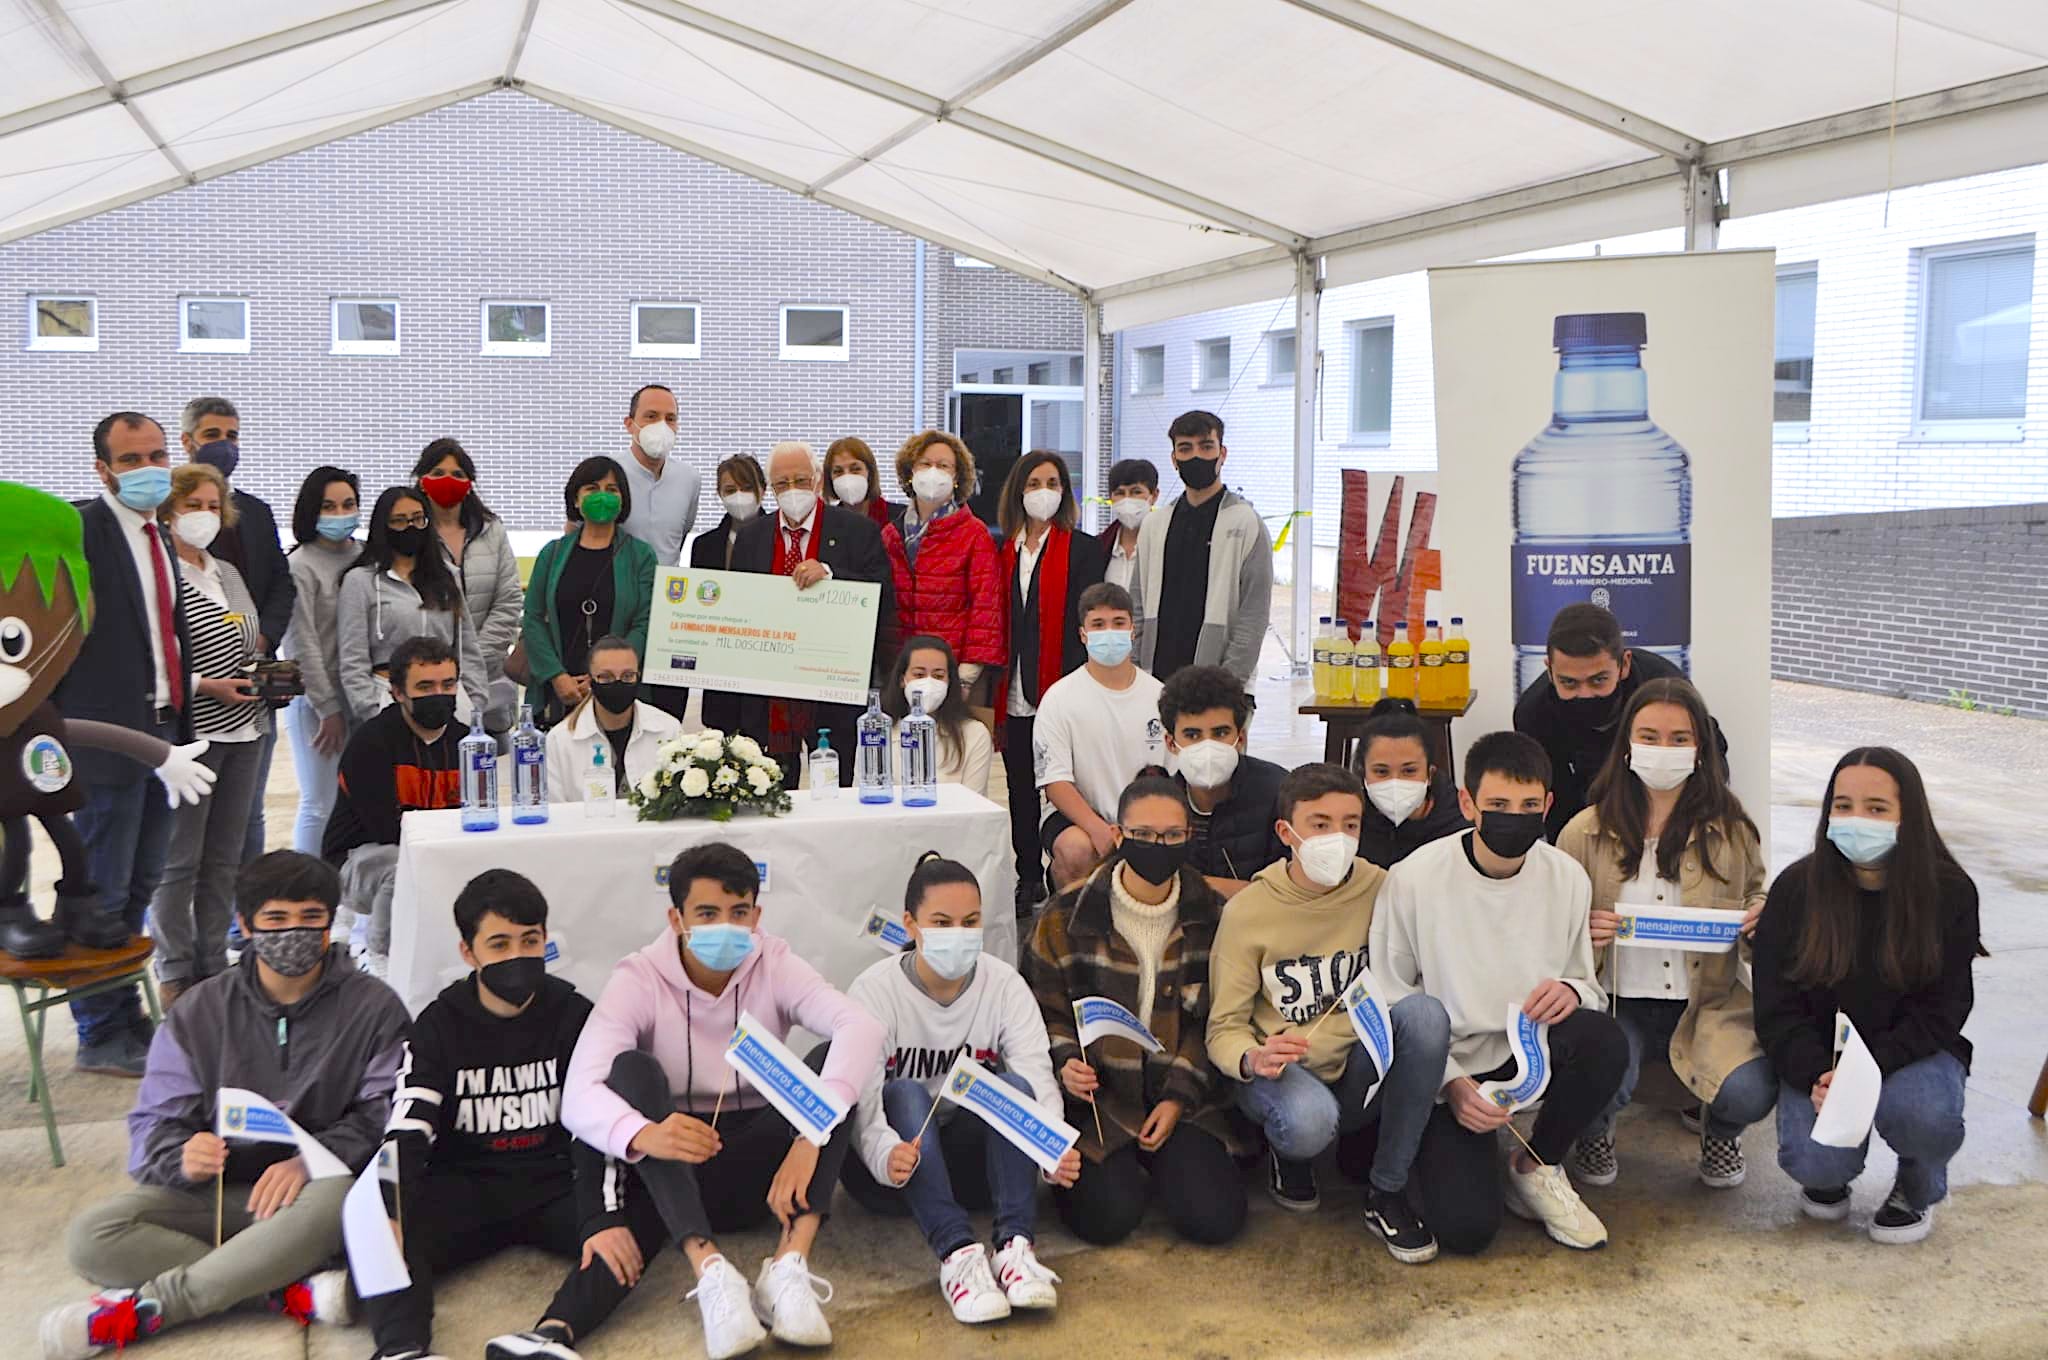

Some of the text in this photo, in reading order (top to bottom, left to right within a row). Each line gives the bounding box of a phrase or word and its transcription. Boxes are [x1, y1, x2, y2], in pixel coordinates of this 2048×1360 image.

[1526, 554, 1675, 576] FUENSANTA
[1576, 577, 1653, 586] MINERO-MEDICINAL
[860, 597, 868, 608] €
[670, 621, 678, 630] LA
[719, 625, 760, 637] MENSAJEROS
[762, 629, 770, 638] DE
[772, 631, 782, 639] LA
[784, 631, 797, 641] PAZ
[715, 637, 794, 655] MIL DOSCIENTOS
[1636, 920, 1694, 937] mensajeros
[1697, 922, 1710, 934] de
[1712, 923, 1722, 935] la
[456, 1068, 486, 1096] I'M
[741, 1038, 833, 1122] mensajeros de la paz
[972, 1081, 1067, 1152] mensajeros de la paz
